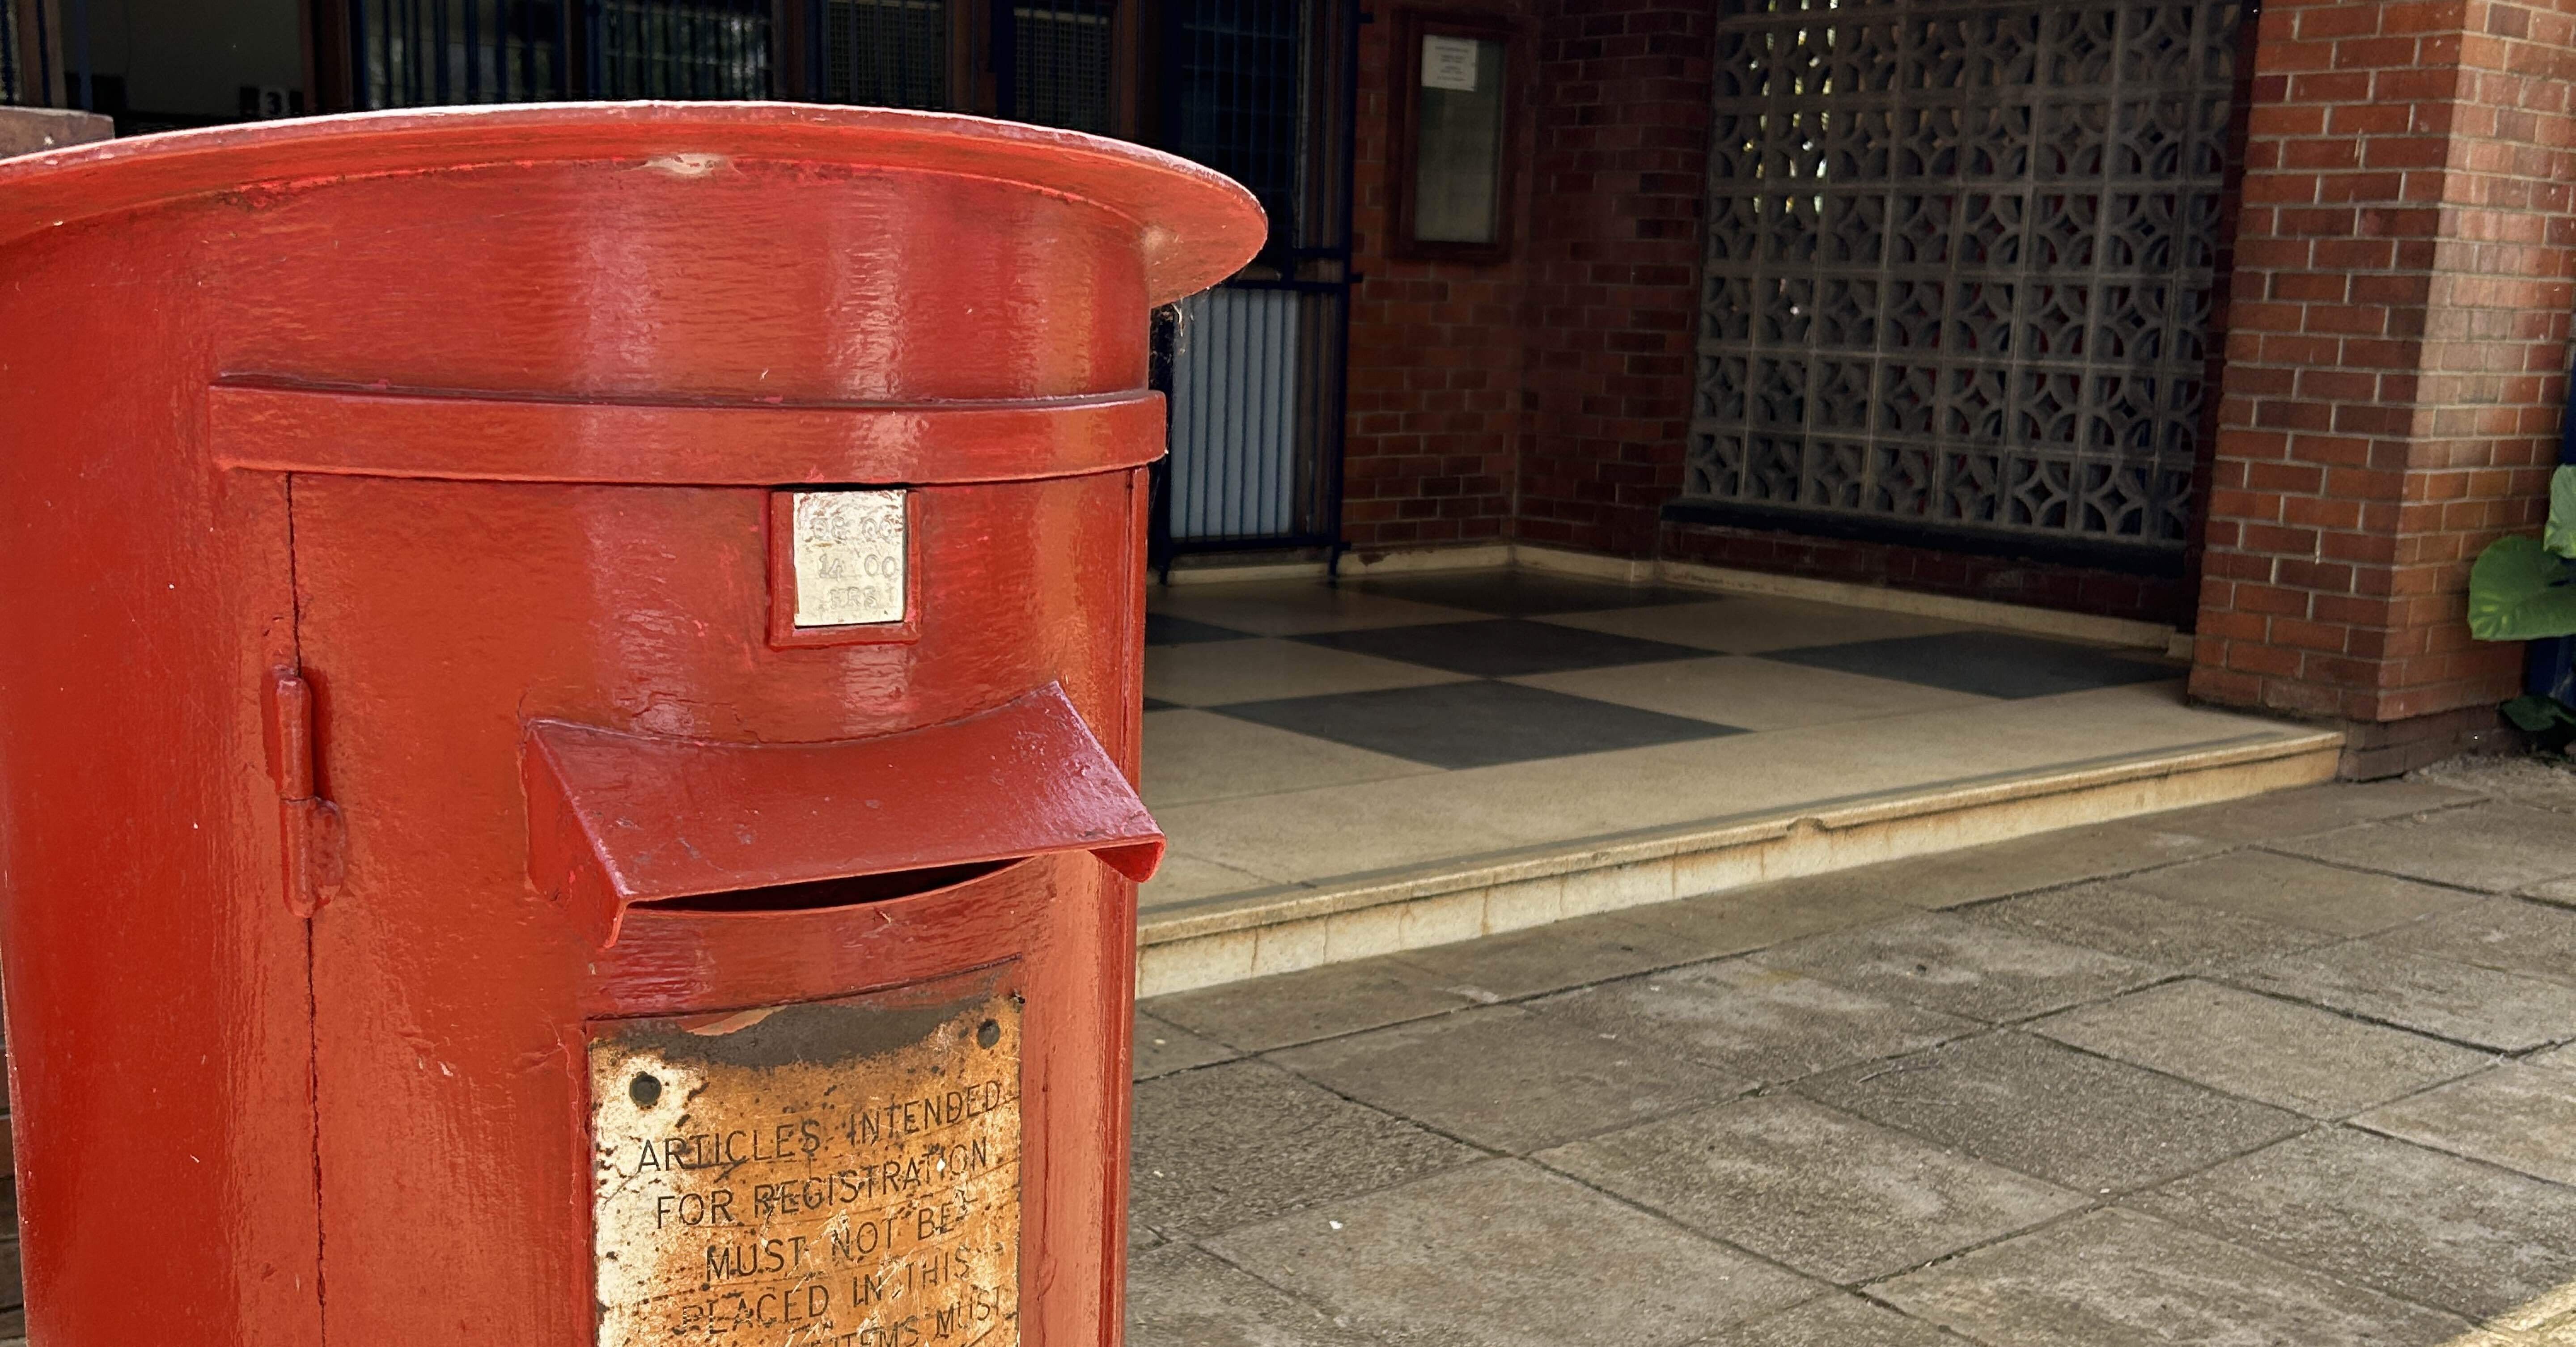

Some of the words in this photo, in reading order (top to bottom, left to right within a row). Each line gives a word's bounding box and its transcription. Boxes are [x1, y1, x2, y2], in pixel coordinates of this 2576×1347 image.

[818, 553, 844, 581] 14
[637, 1118, 821, 1172] ARTICLES
[851, 1080, 1000, 1147] INTENDED
[657, 1189, 734, 1229] FOR
[754, 1136, 987, 1219] REGISTRATION
[707, 1236, 806, 1282] MUST
[831, 1217, 895, 1261] NOT
[918, 1200, 954, 1240] BE
[682, 1285, 829, 1334] PLACED
[853, 1274, 882, 1307] IN
[905, 1246, 970, 1292] THIS
[936, 1285, 1001, 1334] MUST
